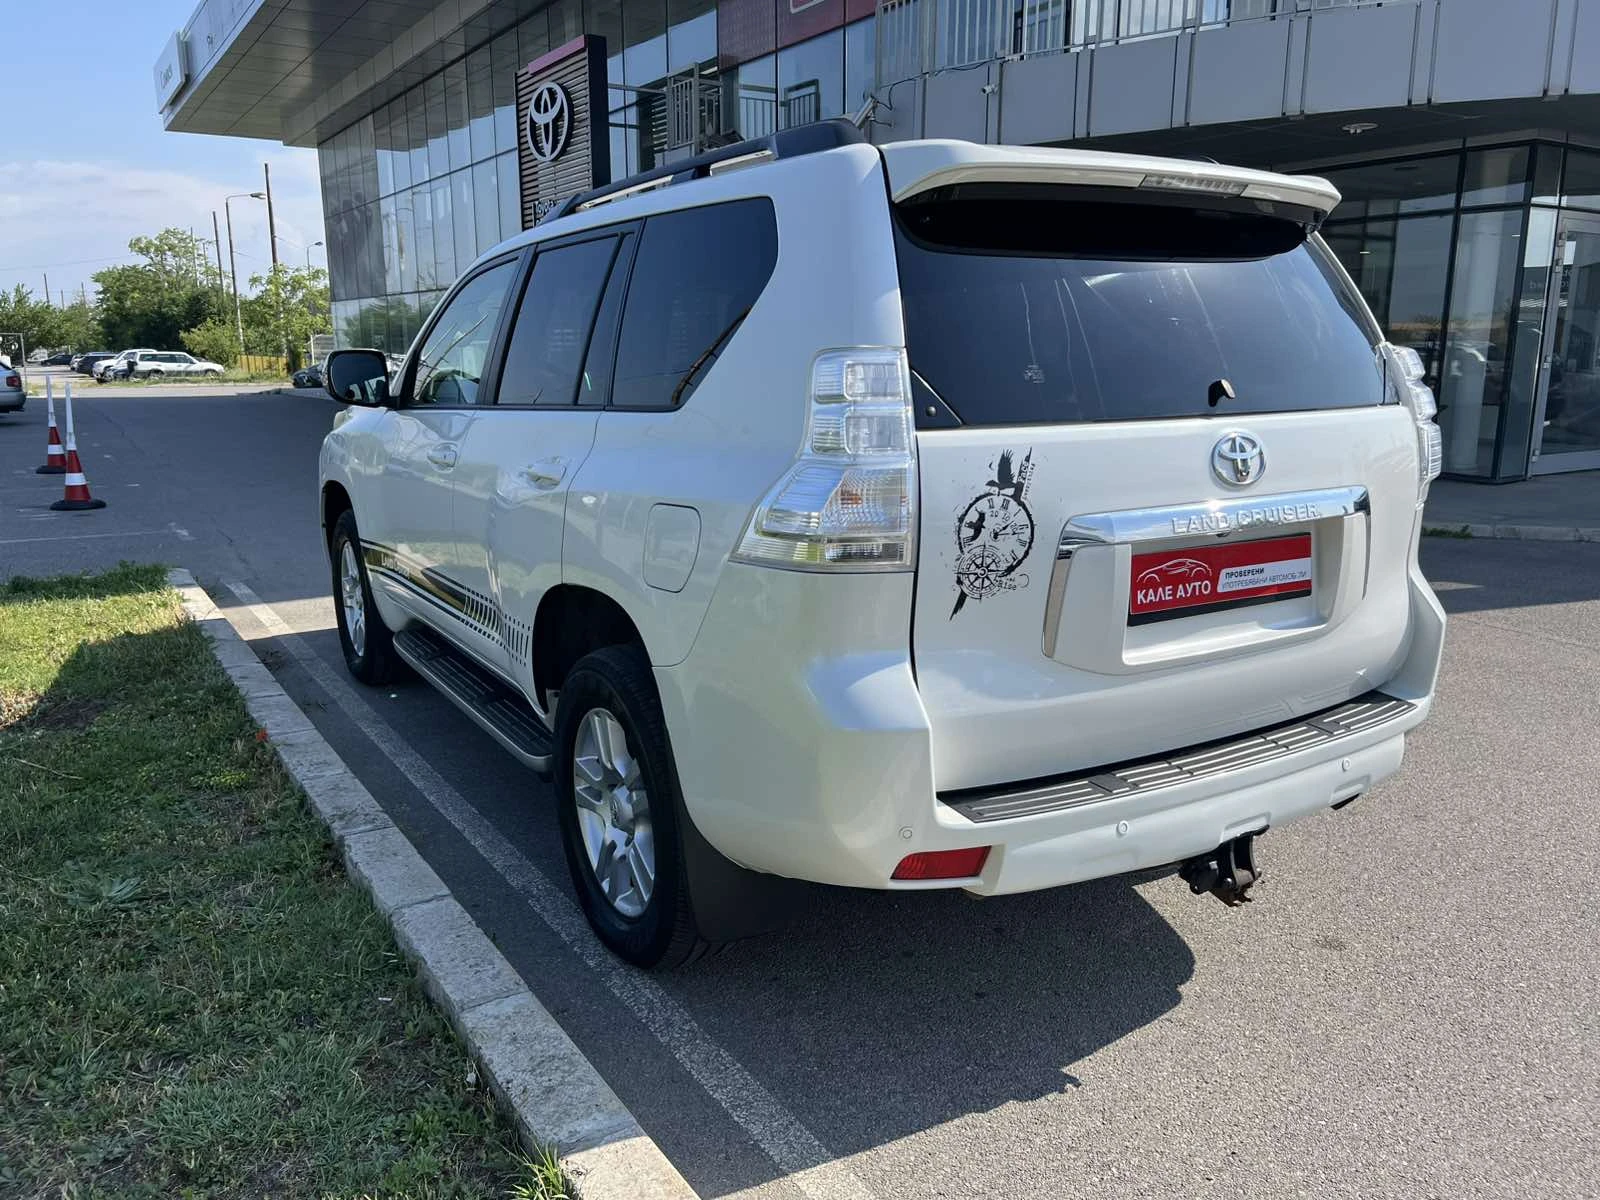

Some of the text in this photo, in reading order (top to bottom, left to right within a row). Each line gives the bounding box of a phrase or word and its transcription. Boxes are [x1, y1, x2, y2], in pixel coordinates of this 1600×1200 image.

[1171, 503, 1320, 535] LAND CRUISER
[1225, 567, 1265, 580] ПРОВЕРЕНИ
[1268, 570, 1308, 584] АВТОМОБЛИ
[1137, 580, 1211, 604] КАЛЕ АУТО
